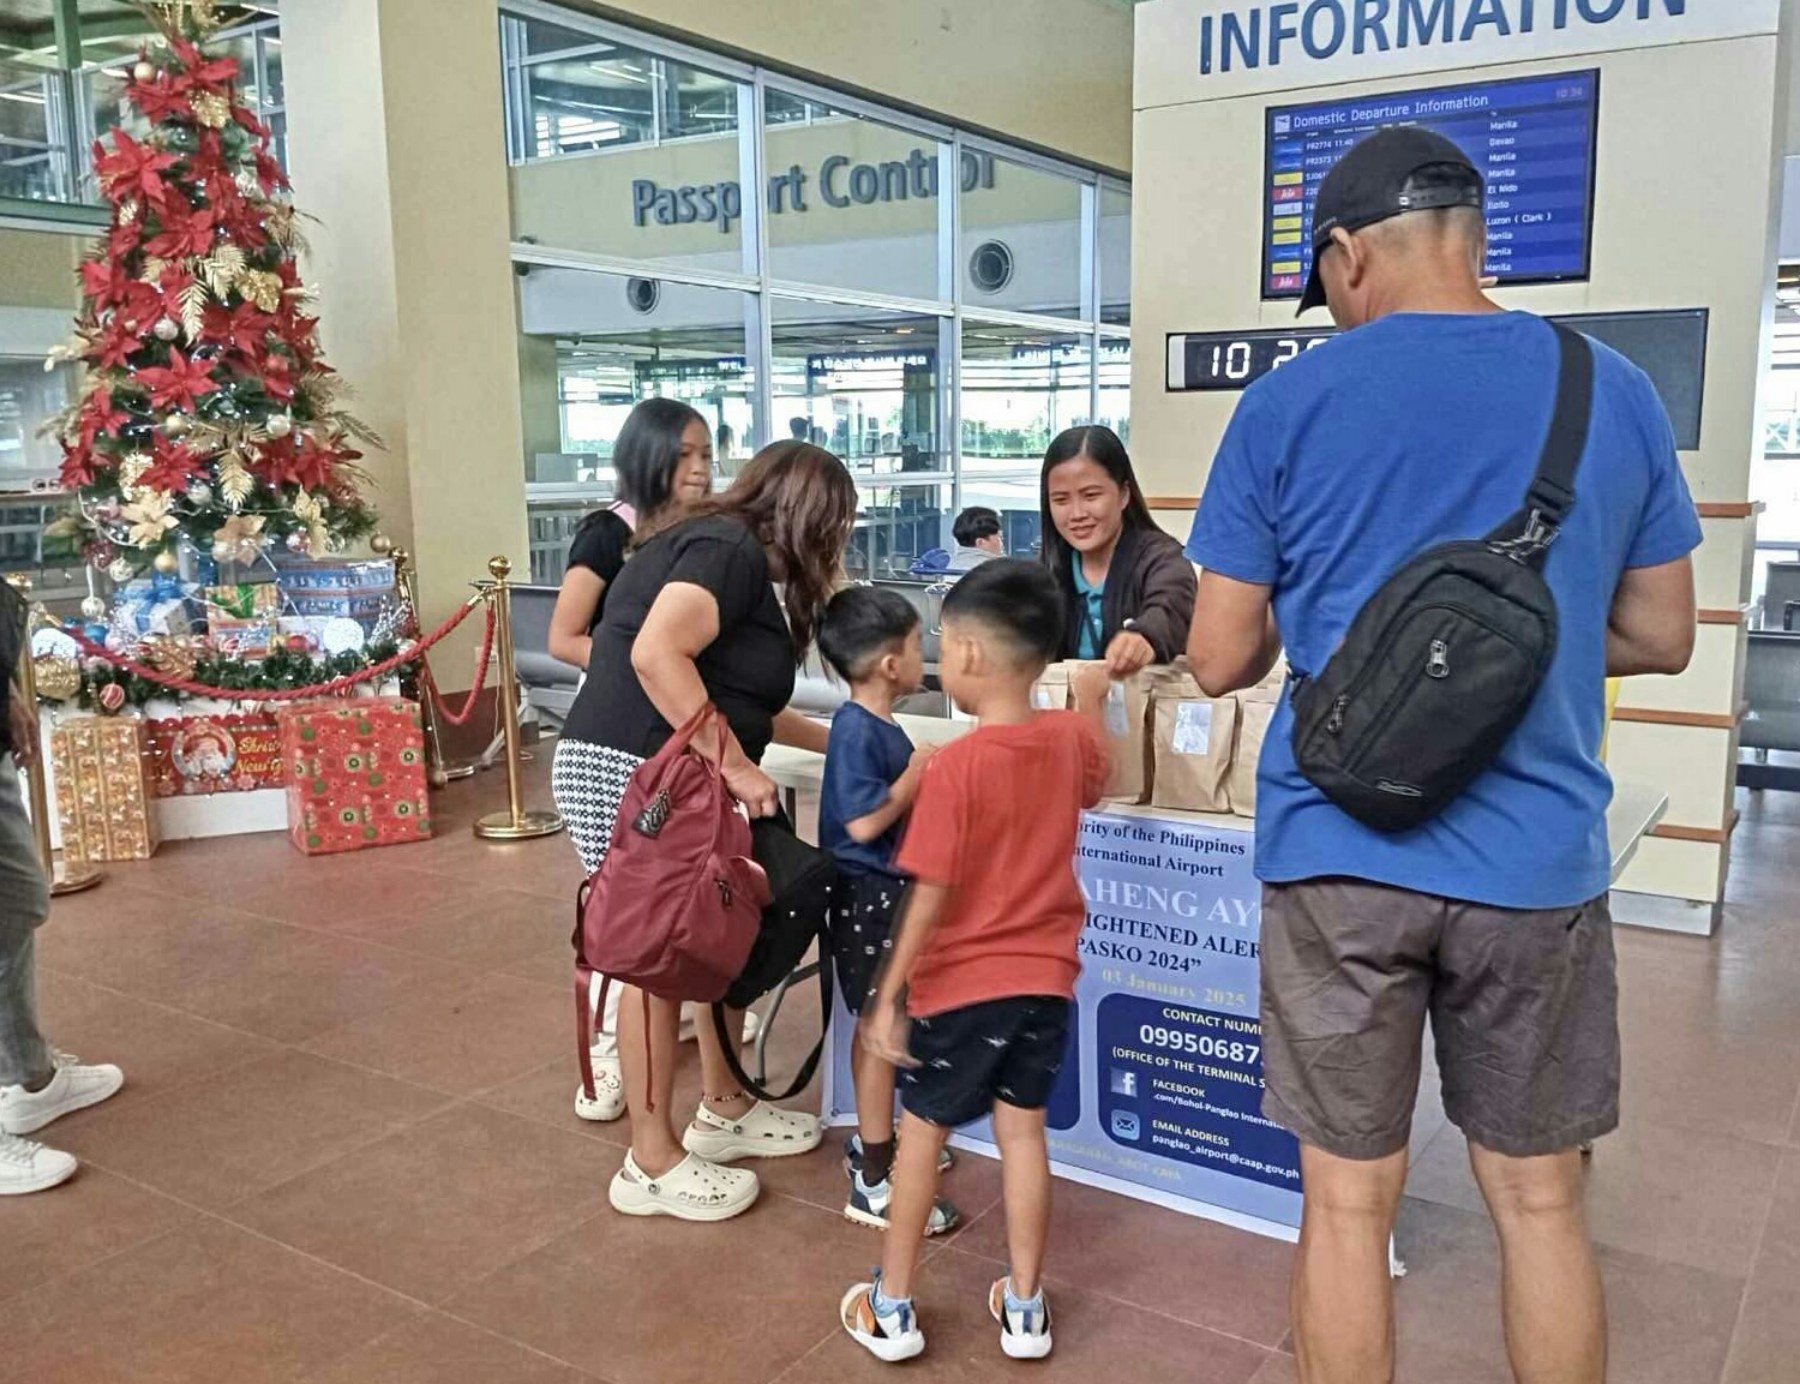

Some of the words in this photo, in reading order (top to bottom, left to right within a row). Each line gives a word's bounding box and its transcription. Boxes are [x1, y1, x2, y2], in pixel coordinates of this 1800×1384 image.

[1293, 112, 1346, 129] Domestic
[1351, 105, 1410, 122] Departure
[1415, 95, 1489, 114] Information
[1489, 152, 1517, 162] Manila
[632, 164, 807, 233] Passprt
[1212, 342, 1250, 379] 10
[1080, 819, 1110, 839] rity
[1114, 826, 1131, 839] of
[1133, 828, 1156, 843] the
[1160, 830, 1246, 856] Philippines
[1165, 857, 1224, 878] Airport
[1207, 896, 1262, 928] AY
[1163, 1006, 1221, 1028] CONTACT
[1139, 1024, 1264, 1067] 09950687
[1112, 1045, 1153, 1065] (OFFICE
[1155, 1056, 1171, 1067] OF
[1173, 1059, 1195, 1073] THE
[1197, 1064, 1257, 1087] TERMINAL
[1152, 1078, 1206, 1098] FACEBOOK
[1152, 1119, 1182, 1134] EMAIL
[1184, 1127, 1230, 1147] ADDRESS
[1152, 1134, 1300, 1179] panglao_airport@caap.gov.ph
